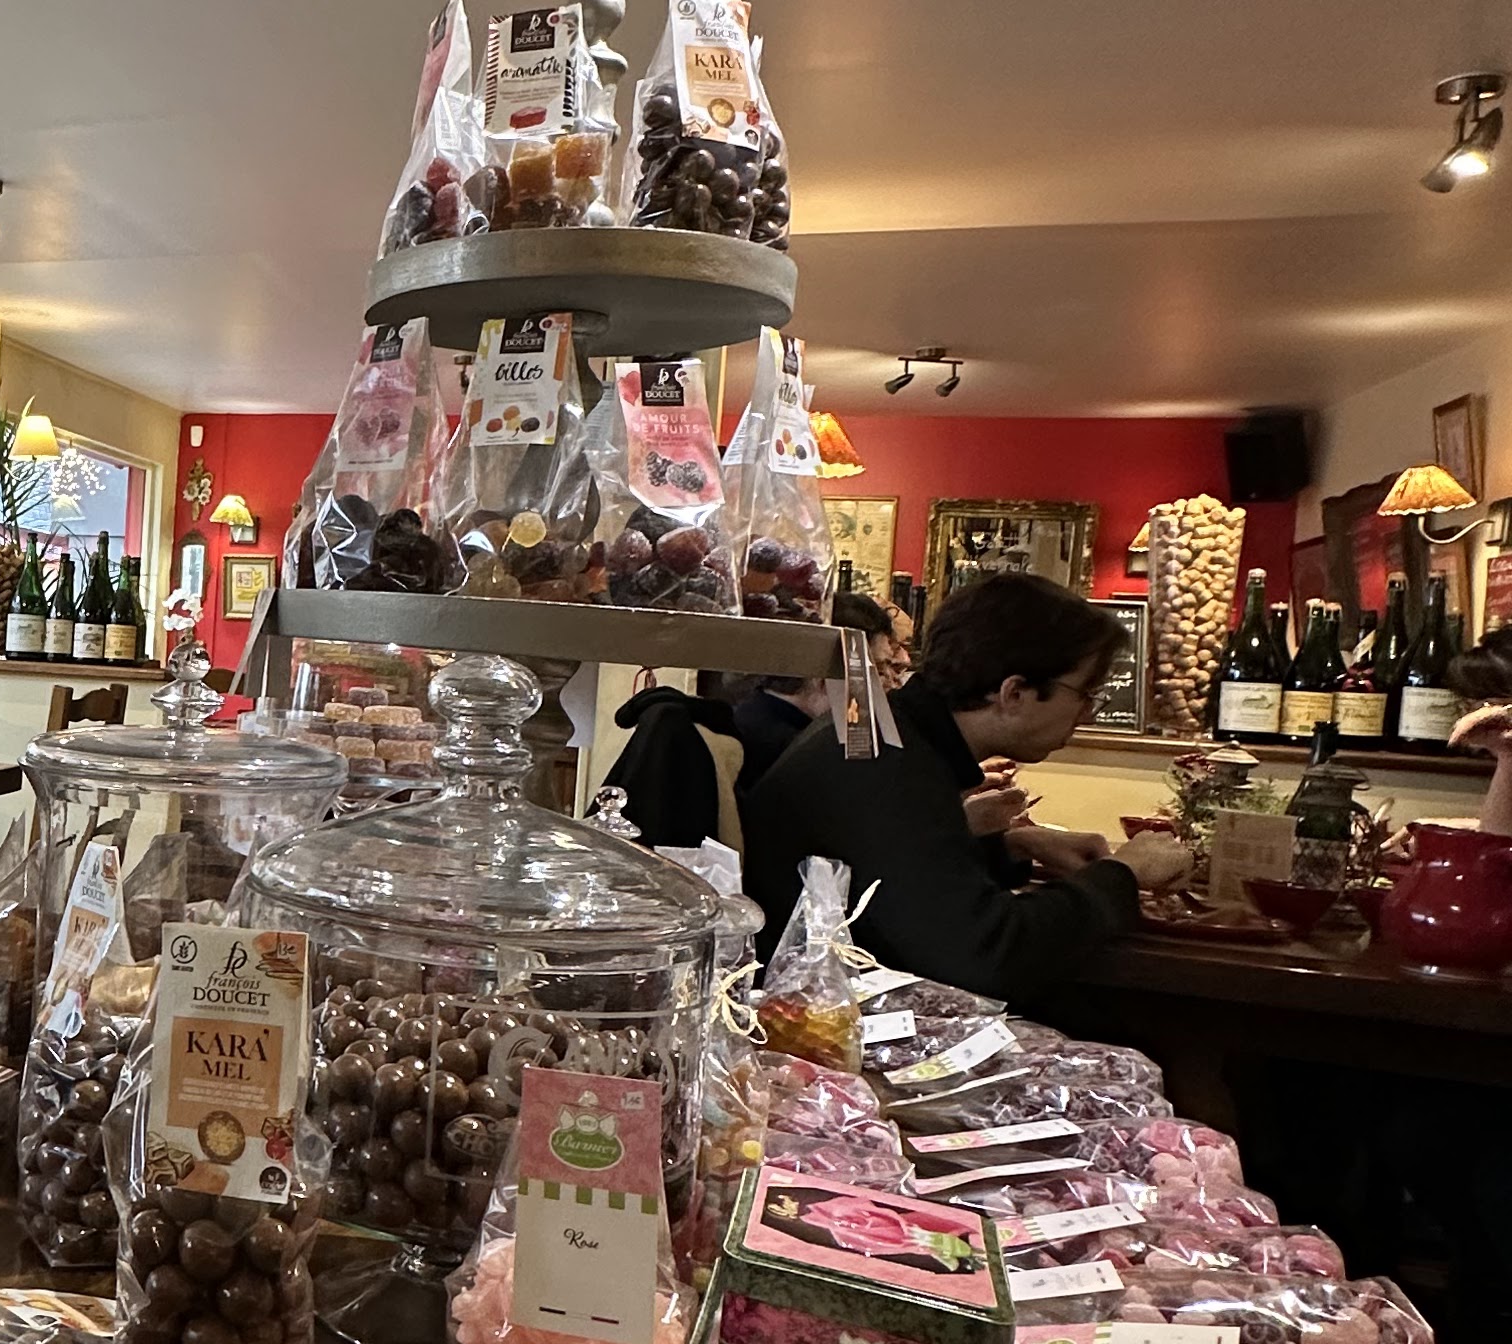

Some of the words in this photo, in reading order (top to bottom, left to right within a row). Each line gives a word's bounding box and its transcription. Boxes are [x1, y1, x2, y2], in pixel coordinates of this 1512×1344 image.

[514, 34, 552, 46] DOUCET
[504, 338, 544, 347] DOUCET
[644, 389, 681, 399] DOUCET
[639, 413, 688, 425] AMOUR
[654, 423, 700, 435] FRUITS
[204, 971, 261, 991] françois
[192, 986, 271, 1007] DOUCET
[201, 1059, 252, 1081] MEL
[563, 1227, 600, 1250] Rose
